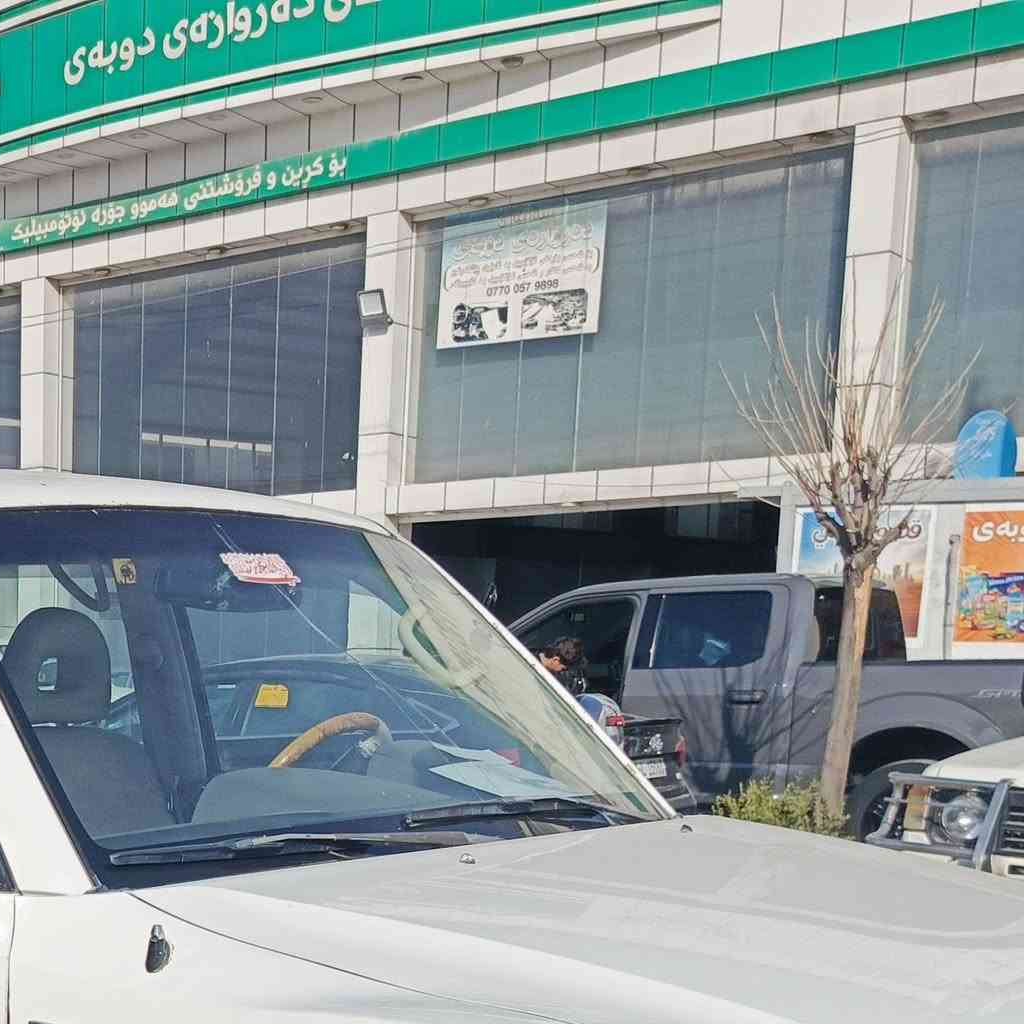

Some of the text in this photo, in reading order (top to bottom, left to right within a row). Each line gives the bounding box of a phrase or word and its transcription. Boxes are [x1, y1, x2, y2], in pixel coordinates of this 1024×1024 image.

[63, 26, 155, 86] دوبەی
[266, 171, 276, 190] و
[486, 285, 510, 297] 0770
[513, 283, 531, 294] 057
